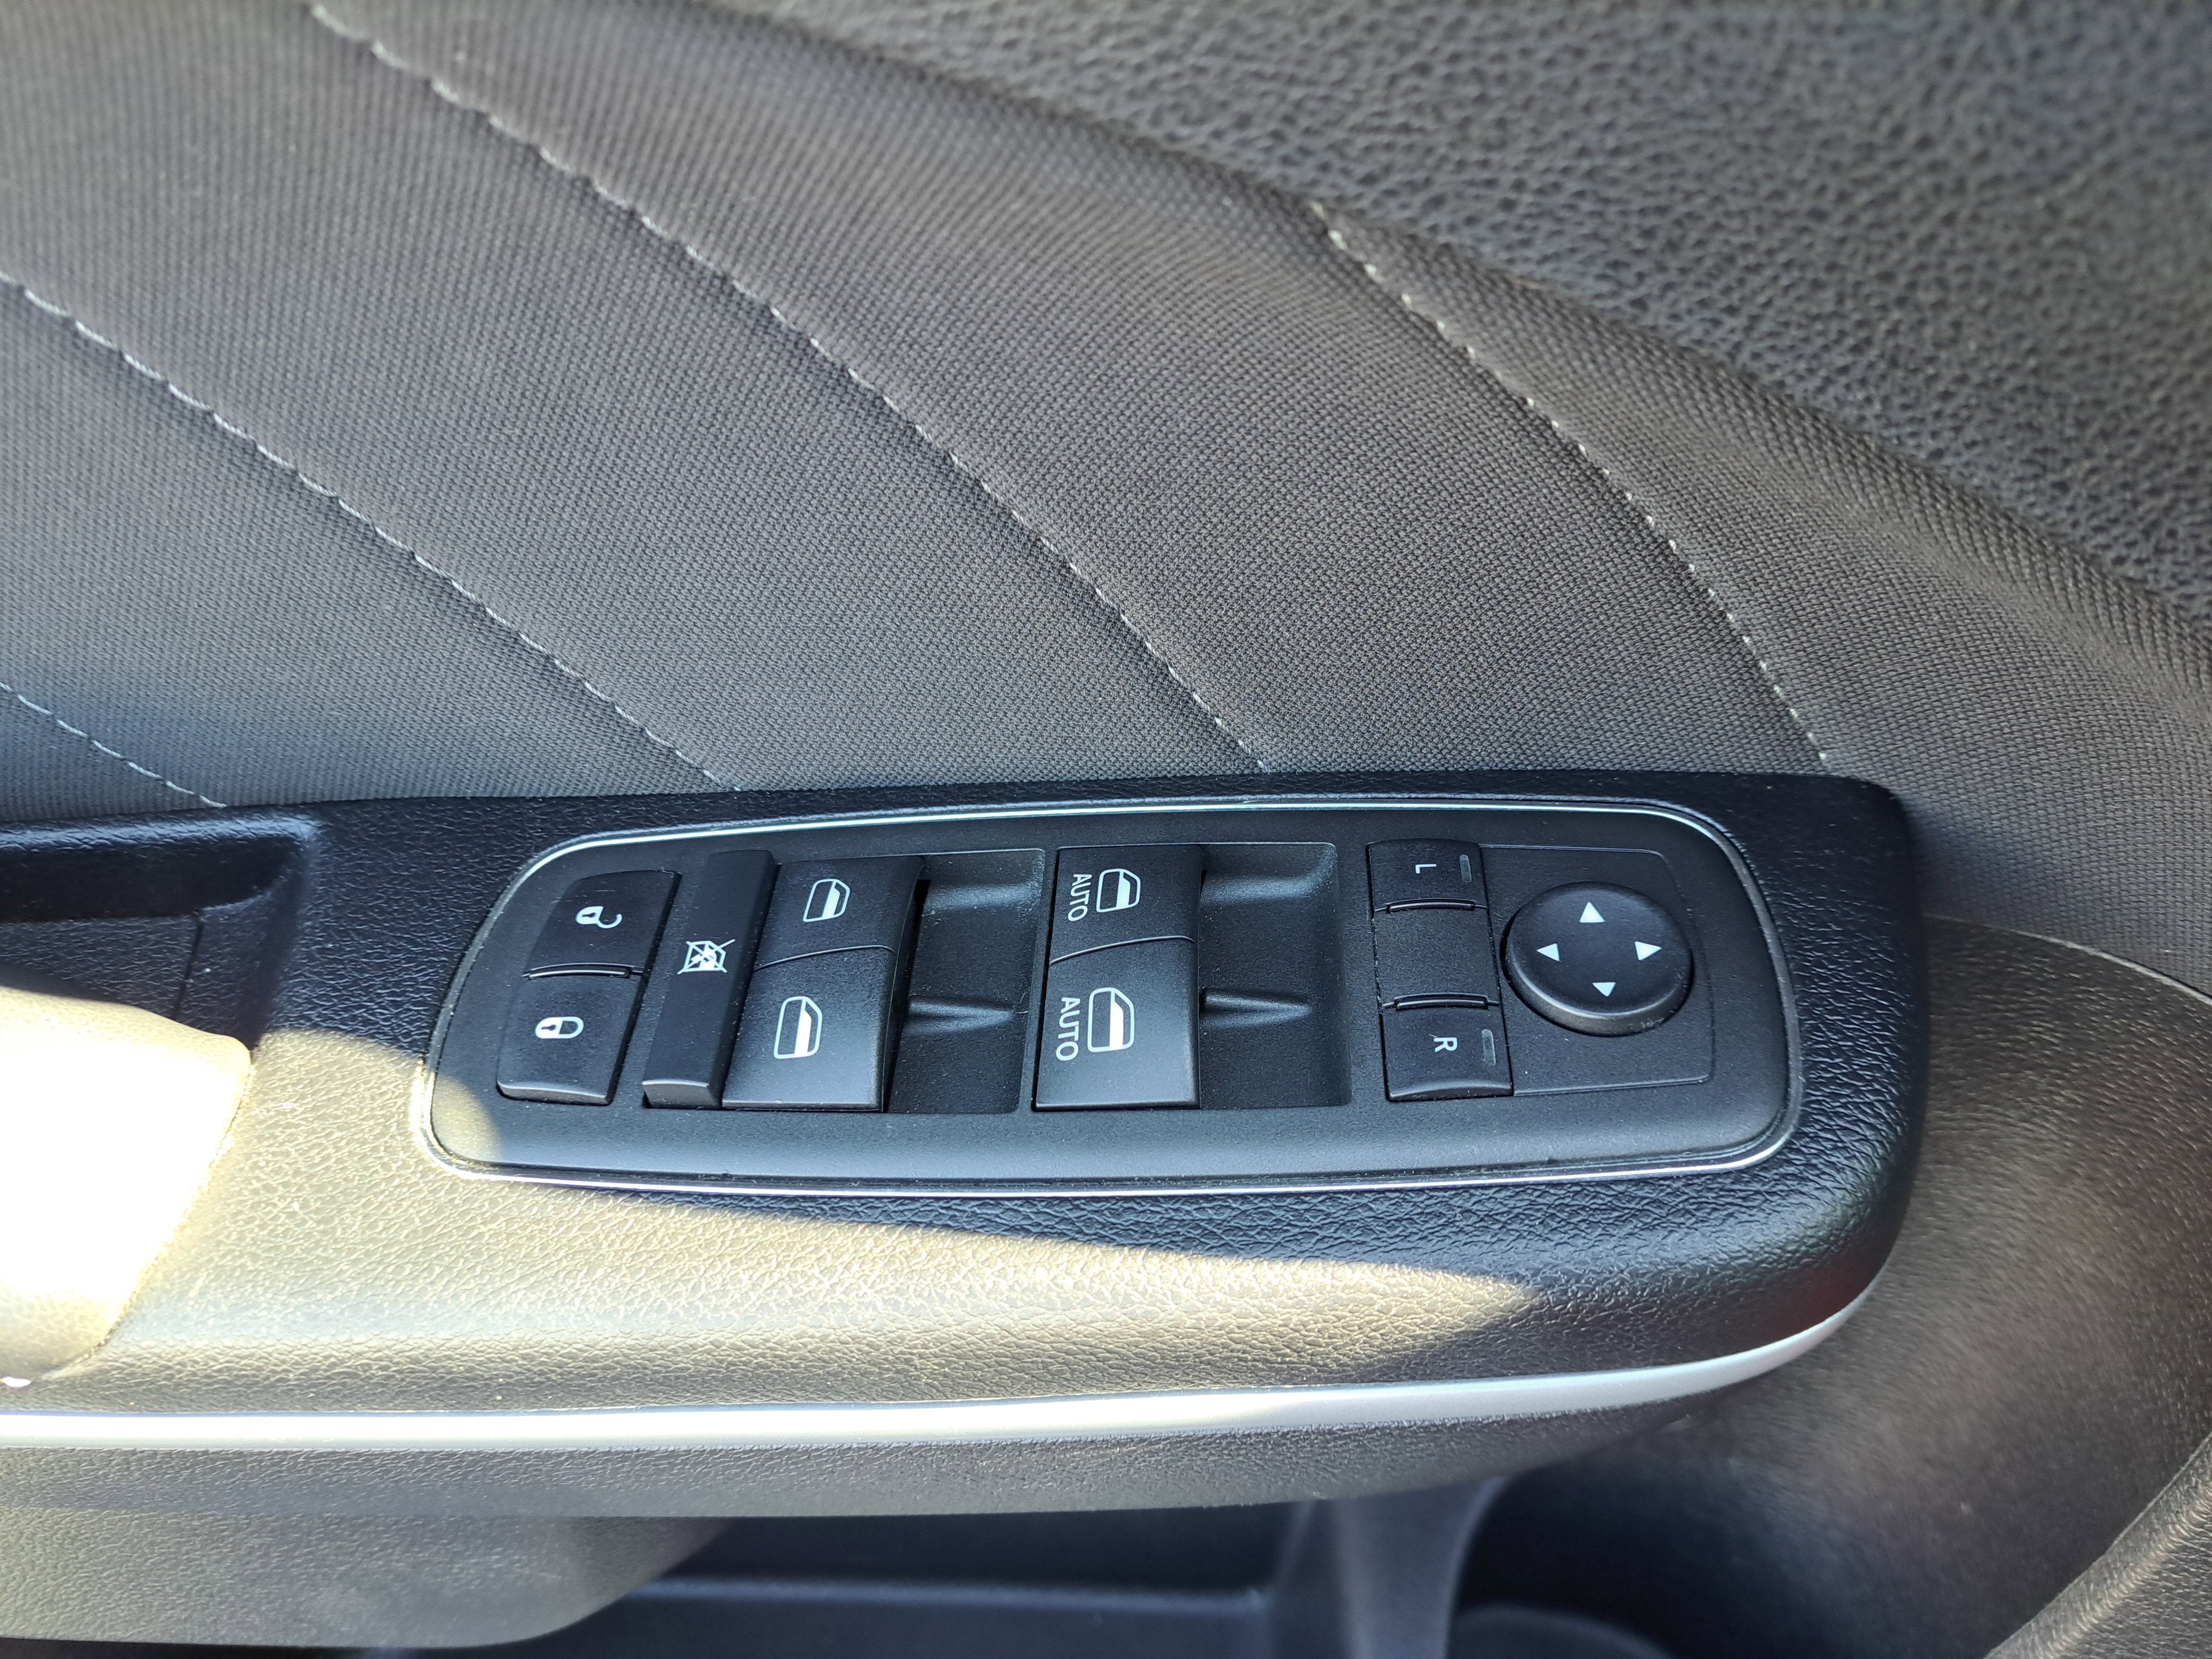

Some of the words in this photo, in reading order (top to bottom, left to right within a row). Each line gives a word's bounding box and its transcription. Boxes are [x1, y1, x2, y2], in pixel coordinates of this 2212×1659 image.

[1415, 863, 1437, 874] L
[1067, 874, 1093, 921] AUTO
[1056, 997, 1081, 1061] AUTO
[1433, 1037, 1458, 1053] R
